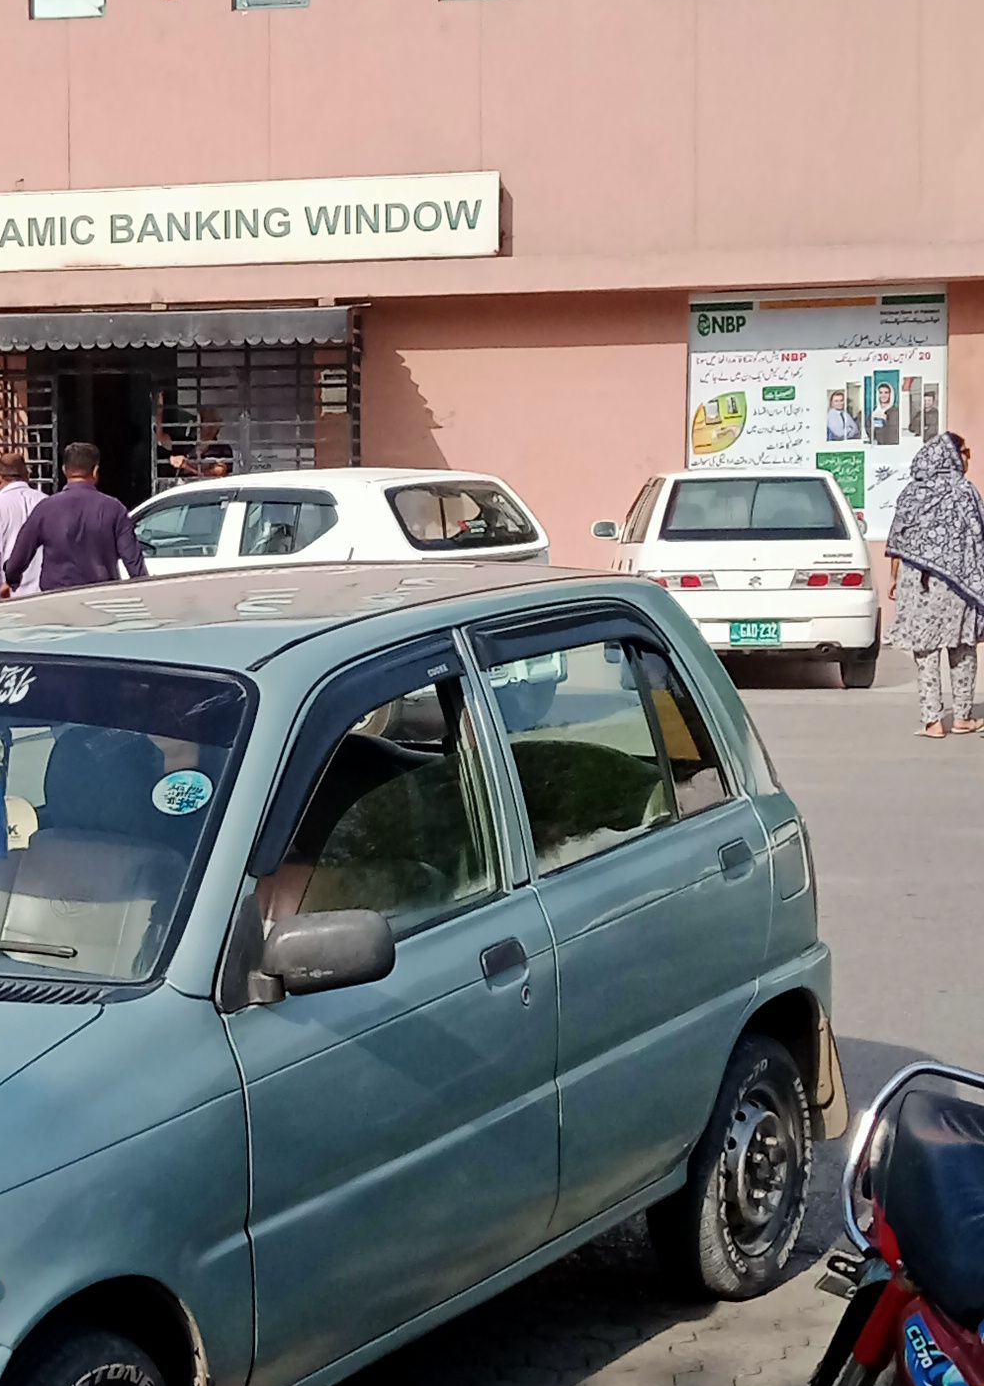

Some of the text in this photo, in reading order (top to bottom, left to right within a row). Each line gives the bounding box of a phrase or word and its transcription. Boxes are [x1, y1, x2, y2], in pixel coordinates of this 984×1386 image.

[109, 206, 292, 245] BANKING
[303, 199, 483, 237] WINDOW
[711, 315, 747, 334] NBP
[905, 1324, 934, 1370] CD70
